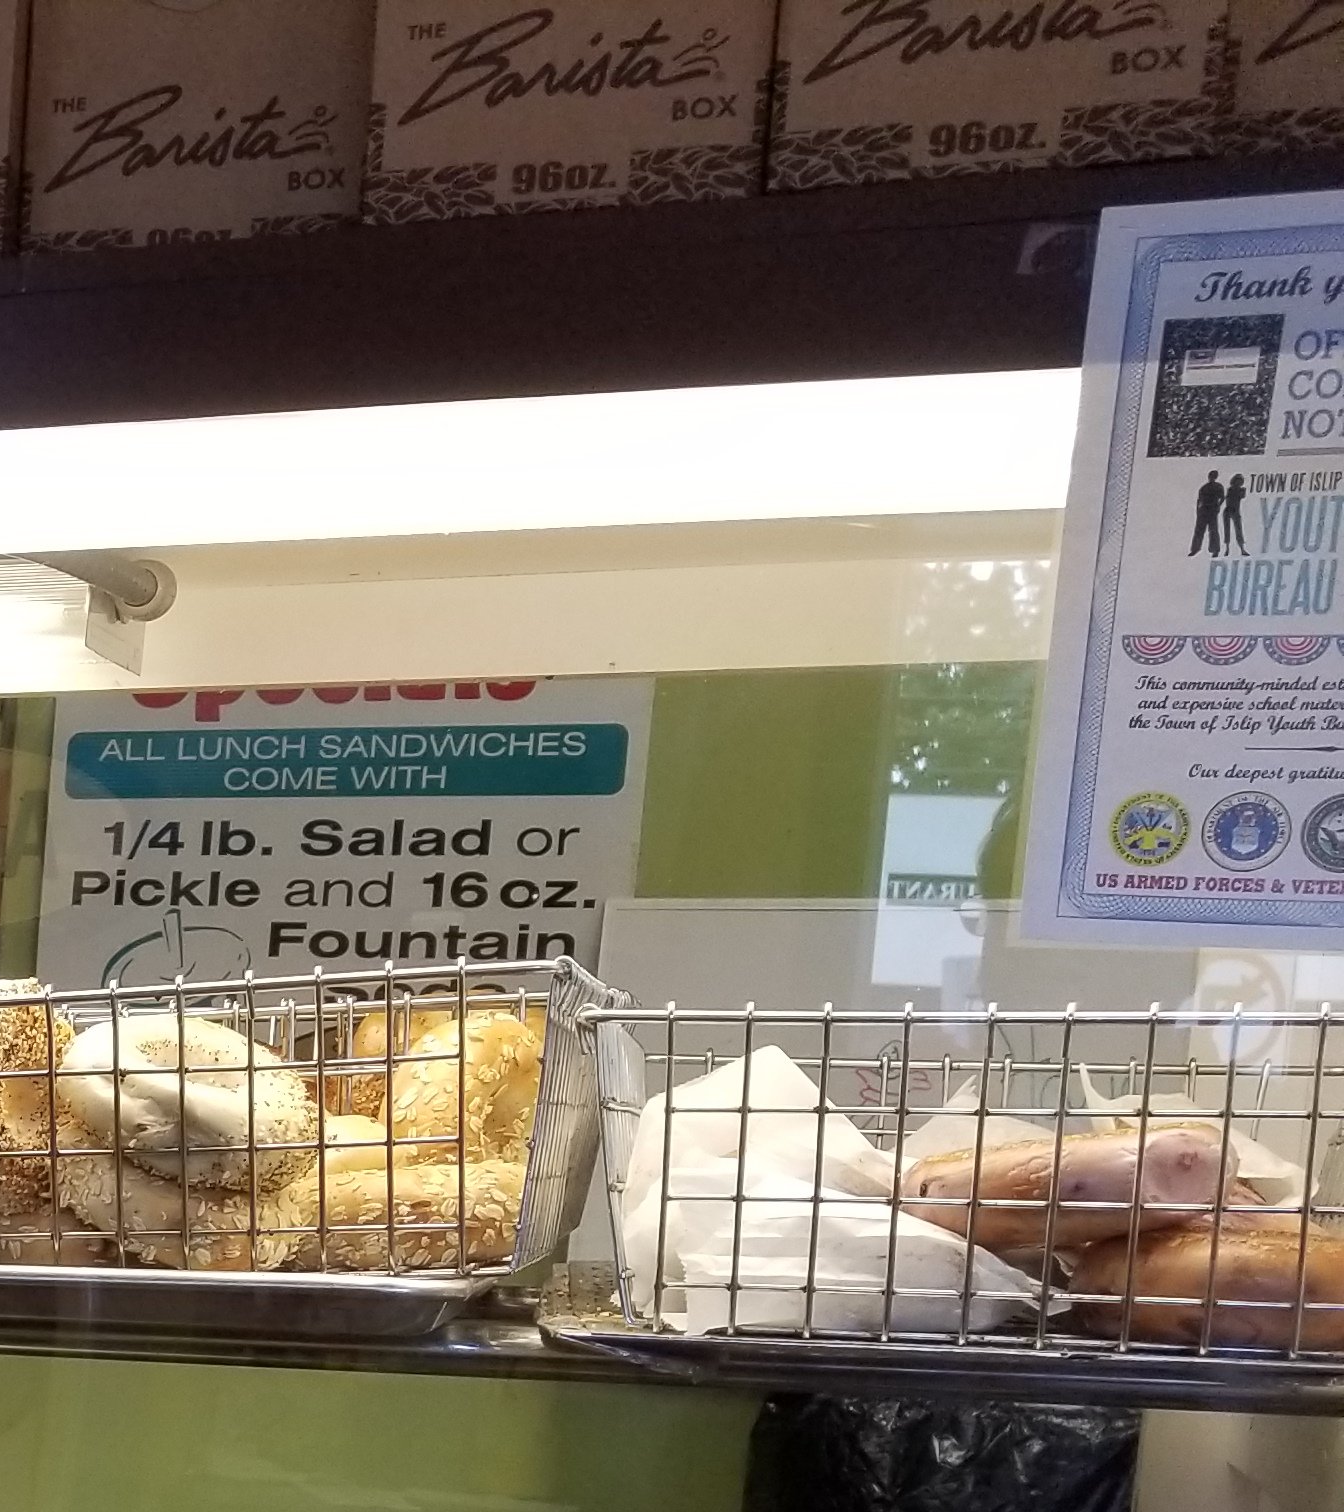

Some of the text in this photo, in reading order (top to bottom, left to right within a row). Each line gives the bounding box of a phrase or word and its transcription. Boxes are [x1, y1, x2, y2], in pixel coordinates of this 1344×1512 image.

[407, 21, 447, 42] THE
[398, 8, 682, 127] Barista
[1111, 45, 1186, 75] BOX
[51, 96, 86, 114] THE
[672, 90, 736, 121] BOX
[44, 85, 299, 195] Barista
[928, 122, 1046, 158] 96oz.
[287, 166, 345, 192] BOX
[512, 163, 617, 195] 96oz.
[1194, 266, 1313, 303] Thank
[1249, 471, 1342, 493] TOWN OF ISLIP
[1204, 559, 1338, 616] BUREAU
[1135, 675, 1167, 691] This
[1172, 675, 1317, 695] community-minded
[1138, 695, 1167, 711] and
[1172, 699, 1244, 714] expensive
[1248, 696, 1296, 711] school
[1129, 714, 1151, 730] the
[1155, 713, 1196, 730] Town
[1201, 715, 1217, 734] of
[1221, 714, 1262, 734] Islip
[1266, 714, 1316, 735] Youth
[100, 731, 587, 762] ALL LUNCH SANDWICHES
[223, 765, 448, 792] COME WITH
[1188, 764, 1219, 778] Our
[1224, 764, 1284, 783] deepest
[103, 818, 581, 859] 1/4 lb. Salad or
[70, 868, 262, 908] Pickle
[284, 873, 393, 909] and
[1096, 874, 1118, 888] US
[1124, 874, 1187, 890] ARMED
[1193, 876, 1265, 893] FORCES
[1270, 881, 1284, 894] &
[268, 921, 578, 960] Fountain
